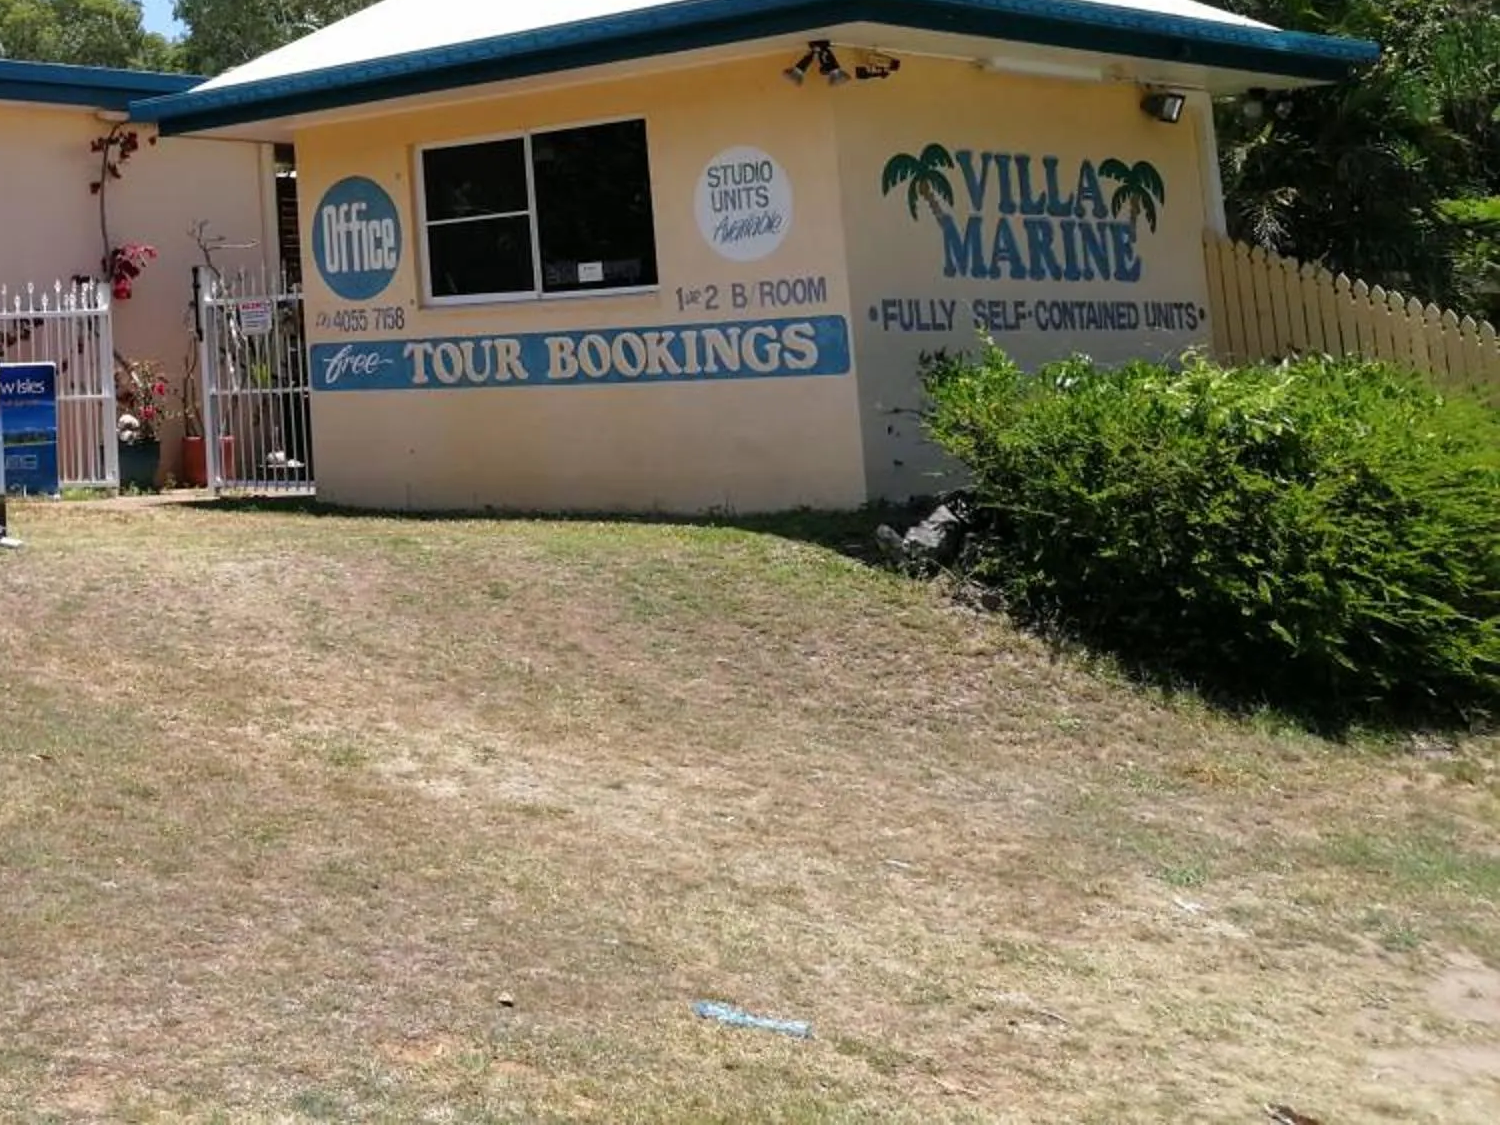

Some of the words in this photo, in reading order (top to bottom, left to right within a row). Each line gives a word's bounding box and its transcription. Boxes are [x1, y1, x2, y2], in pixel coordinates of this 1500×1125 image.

[707, 160, 773, 188] STUDIO
[955, 149, 1109, 218] VILLA
[711, 185, 770, 213] UNITS
[322, 202, 397, 275] Office
[942, 214, 1142, 282] MARINE
[705, 284, 719, 310] 2
[881, 299, 957, 331] FULLY
[1144, 302, 1198, 331] UNITS
[323, 344, 393, 384] free
[403, 336, 528, 385] TOUR
[544, 322, 820, 381] BOOKINGS
